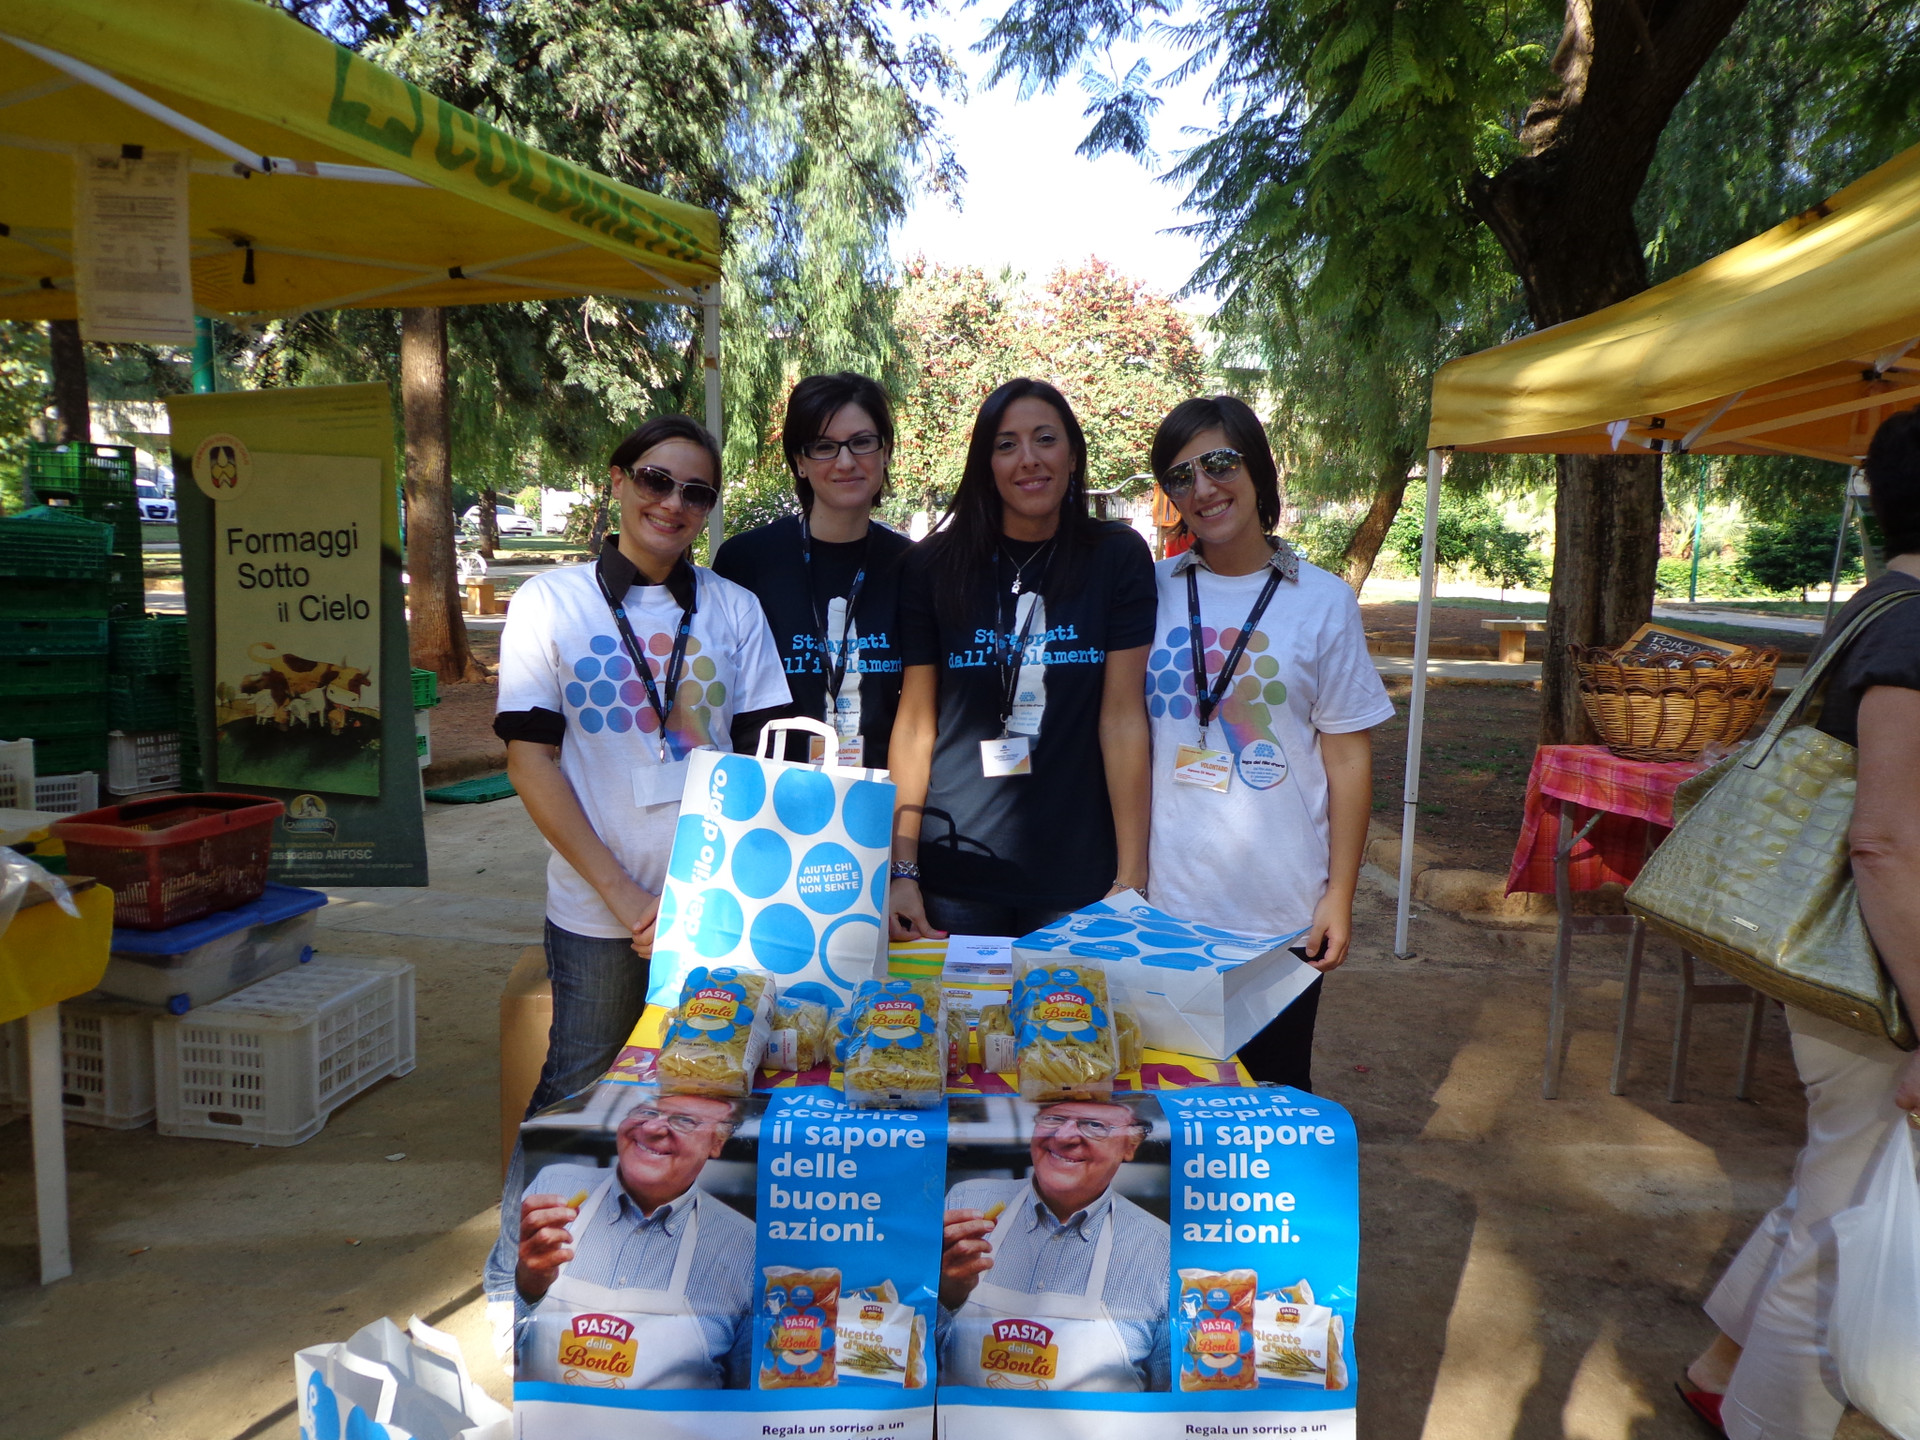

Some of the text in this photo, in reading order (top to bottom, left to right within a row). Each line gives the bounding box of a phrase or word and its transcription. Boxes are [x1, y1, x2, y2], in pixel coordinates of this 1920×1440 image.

[227, 522, 359, 558] Formaggi
[238, 562, 310, 591] Sotto
[278, 593, 371, 623] il Cielo
[703, 768, 728, 840] d'oro
[272, 849, 373, 860] associato ANFOSC
[803, 862, 852, 875] AIUTA CHI
[799, 871, 859, 885] NON VEDE E
[800, 882, 859, 894] NON SENTE
[699, 990, 732, 1001] PASTA
[1049, 993, 1083, 1004] PASTA
[878, 1001, 912, 1010] PASTA
[1171, 1094, 1291, 1107] Vieni a
[776, 1108, 918, 1123] scoprire
[1178, 1105, 1320, 1122] scoprire
[772, 1120, 926, 1153] il sapore
[1184, 1121, 1336, 1153] il sapore
[770, 1152, 857, 1179] delle
[1184, 1152, 1270, 1179] delle
[769, 1184, 881, 1211] buone
[1183, 1186, 1296, 1212] buone
[768, 1216, 885, 1242] azioni.
[1183, 1217, 1300, 1243] azioni.
[578, 1318, 628, 1340] PASTA
[784, 1318, 815, 1329] PASTA
[1202, 1321, 1232, 1333] PASTA
[836, 1327, 884, 1343] Ricette
[998, 1324, 1047, 1345] PASTA
[1254, 1330, 1301, 1345] Ricette
[586, 1338, 613, 1350] della
[1008, 1343, 1034, 1354] della
[762, 1424, 805, 1438] Regala
[809, 1425, 826, 1434] un
[829, 1422, 874, 1434] sorriso
[878, 1423, 885, 1431] a
[889, 1420, 905, 1429] un
[1185, 1422, 1327, 1437] Regala un sorriso a un
